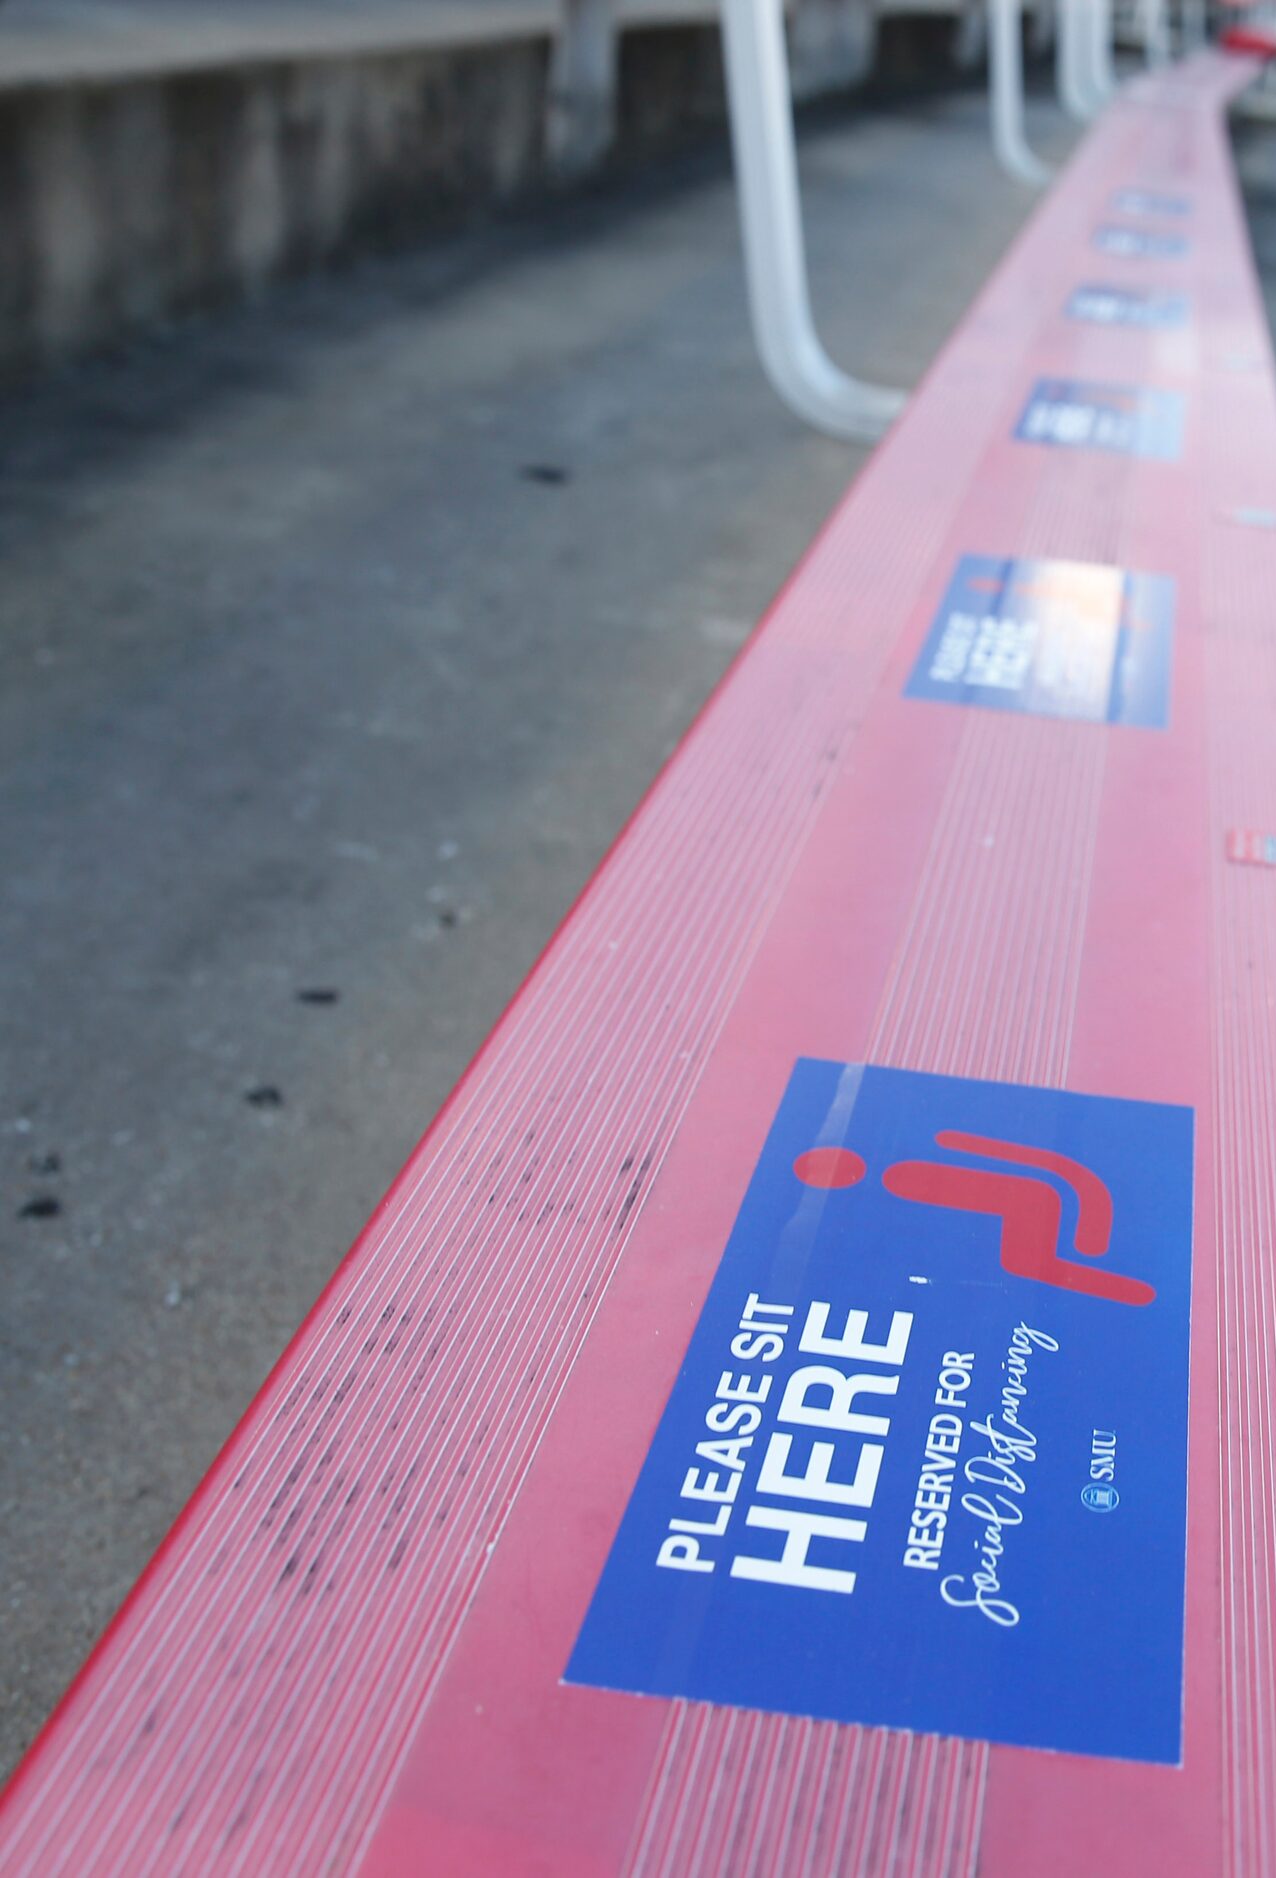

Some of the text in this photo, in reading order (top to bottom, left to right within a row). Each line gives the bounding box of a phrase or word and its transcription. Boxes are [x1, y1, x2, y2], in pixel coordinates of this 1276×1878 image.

[656, 1292, 796, 1573] PLEASE SIT
[730, 1301, 914, 1594] HERE
[903, 1350, 977, 1571] RESERVED FOR
[941, 1320, 1060, 1627] Social Distancing
[1088, 1429, 1119, 1481] SMU
